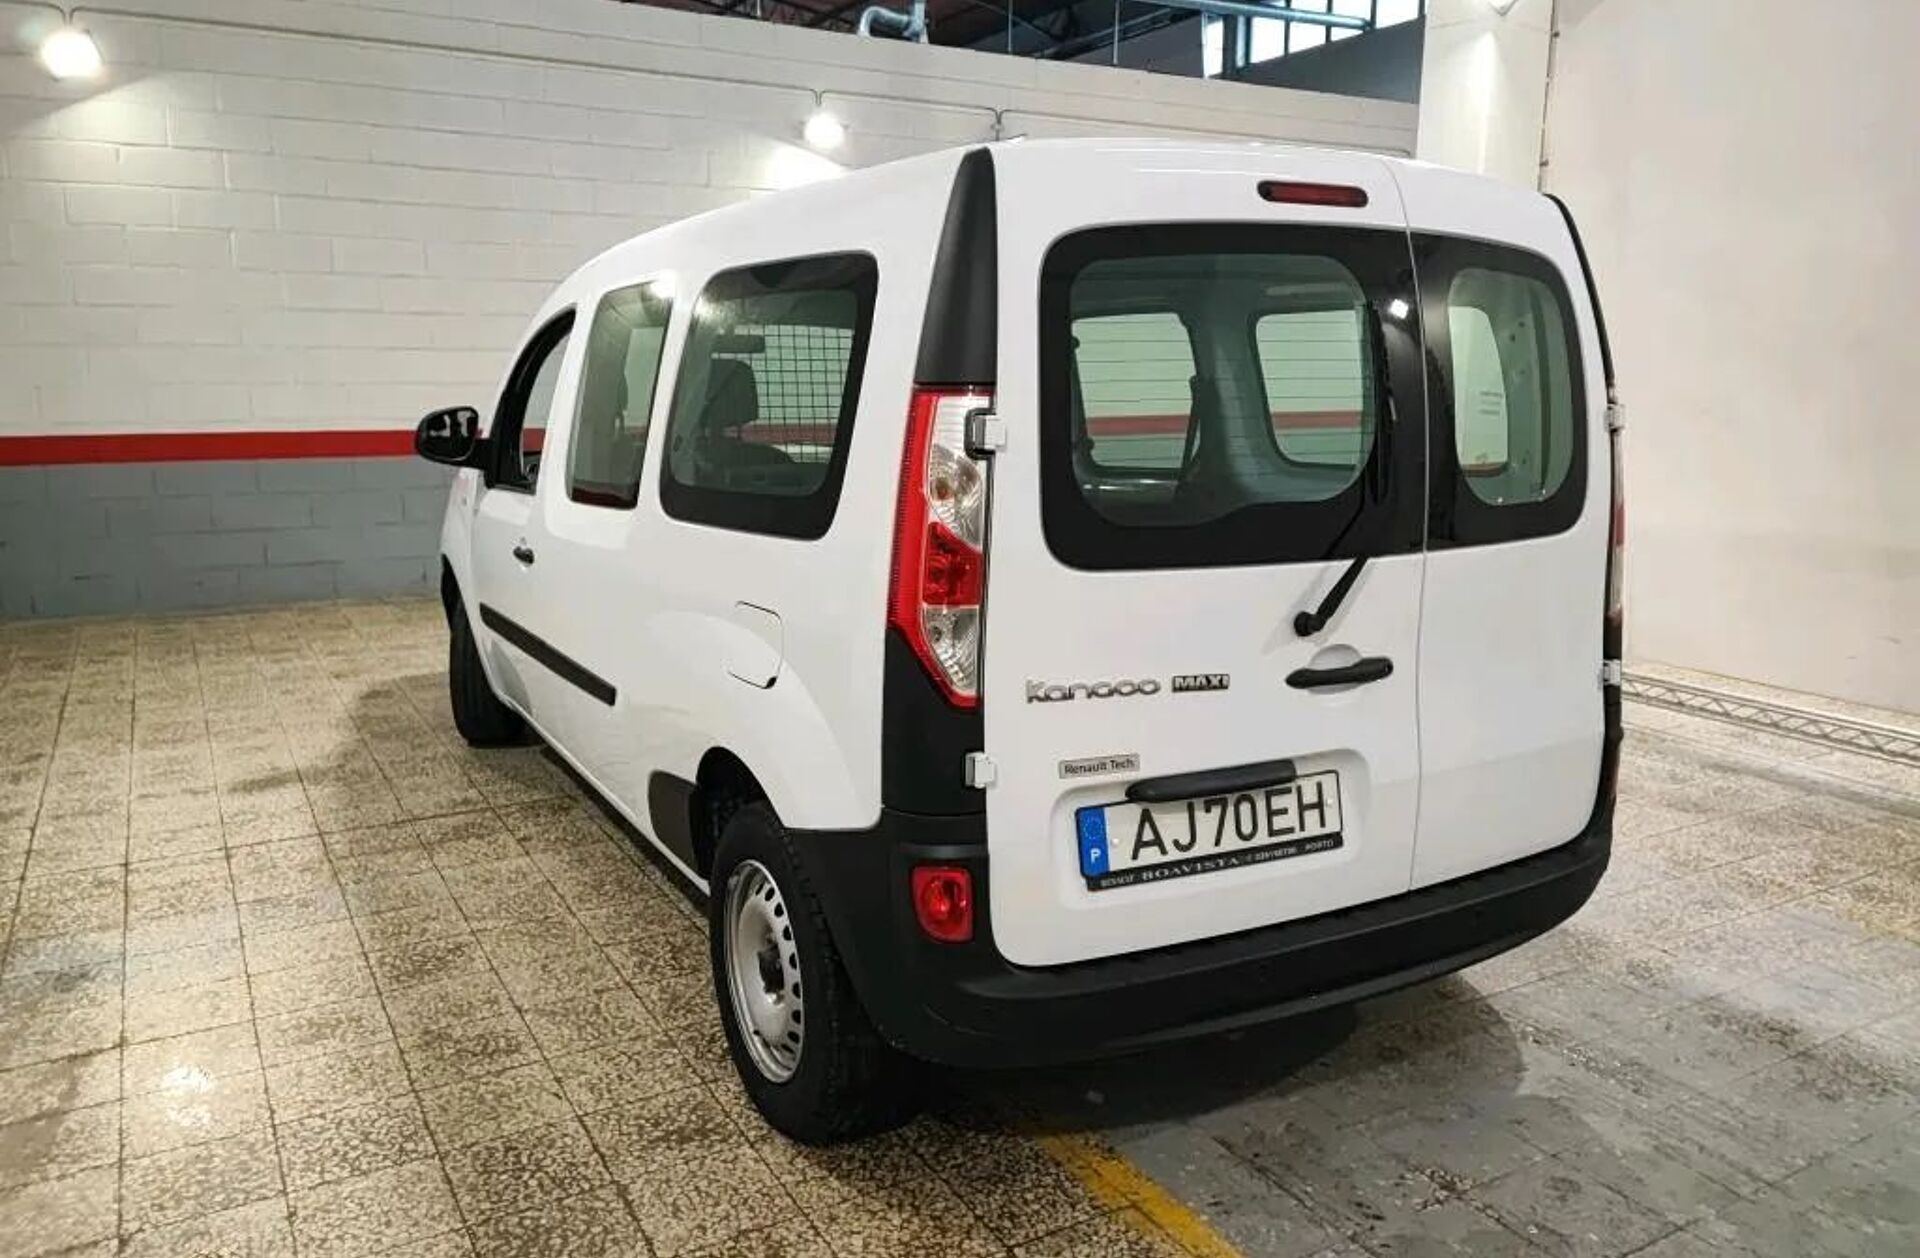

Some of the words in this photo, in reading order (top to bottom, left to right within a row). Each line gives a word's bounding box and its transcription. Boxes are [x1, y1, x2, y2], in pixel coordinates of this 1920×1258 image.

[1173, 674, 1229, 690] MAXI
[1109, 758, 1135, 770] Tech
[1131, 781, 1326, 860] AJ70EH
[1091, 848, 1101, 863] P
[1142, 857, 1239, 880] BOAVISTA
